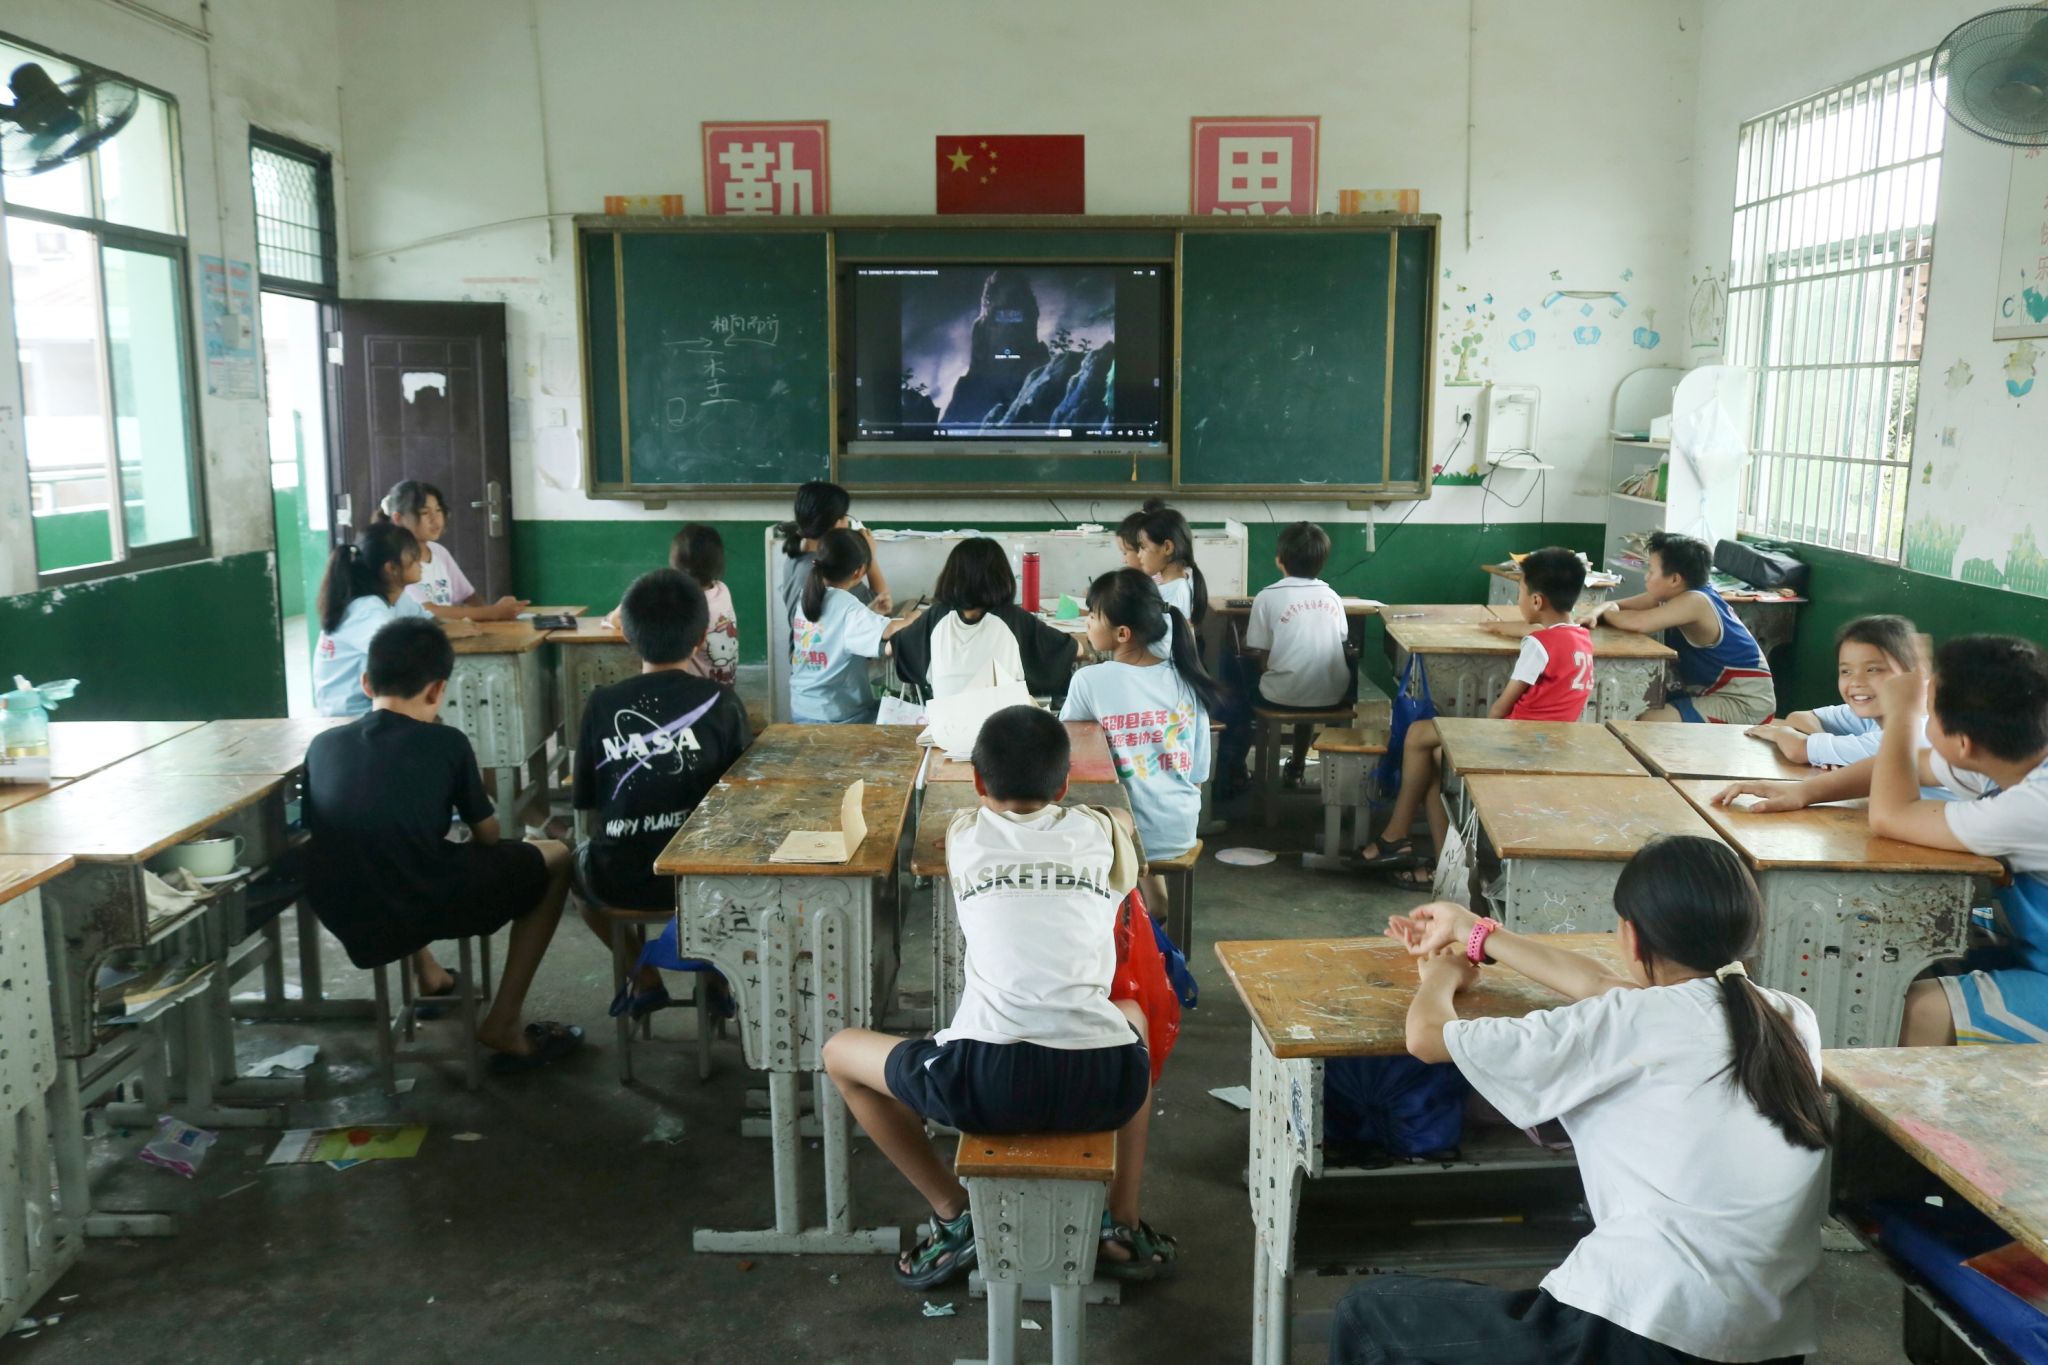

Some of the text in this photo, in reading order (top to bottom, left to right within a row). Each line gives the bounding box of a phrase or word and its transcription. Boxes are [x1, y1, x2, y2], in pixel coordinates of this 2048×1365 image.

[719, 142, 812, 214] 勤
[602, 727, 701, 761] NASA
[606, 818, 639, 838] HAPPY
